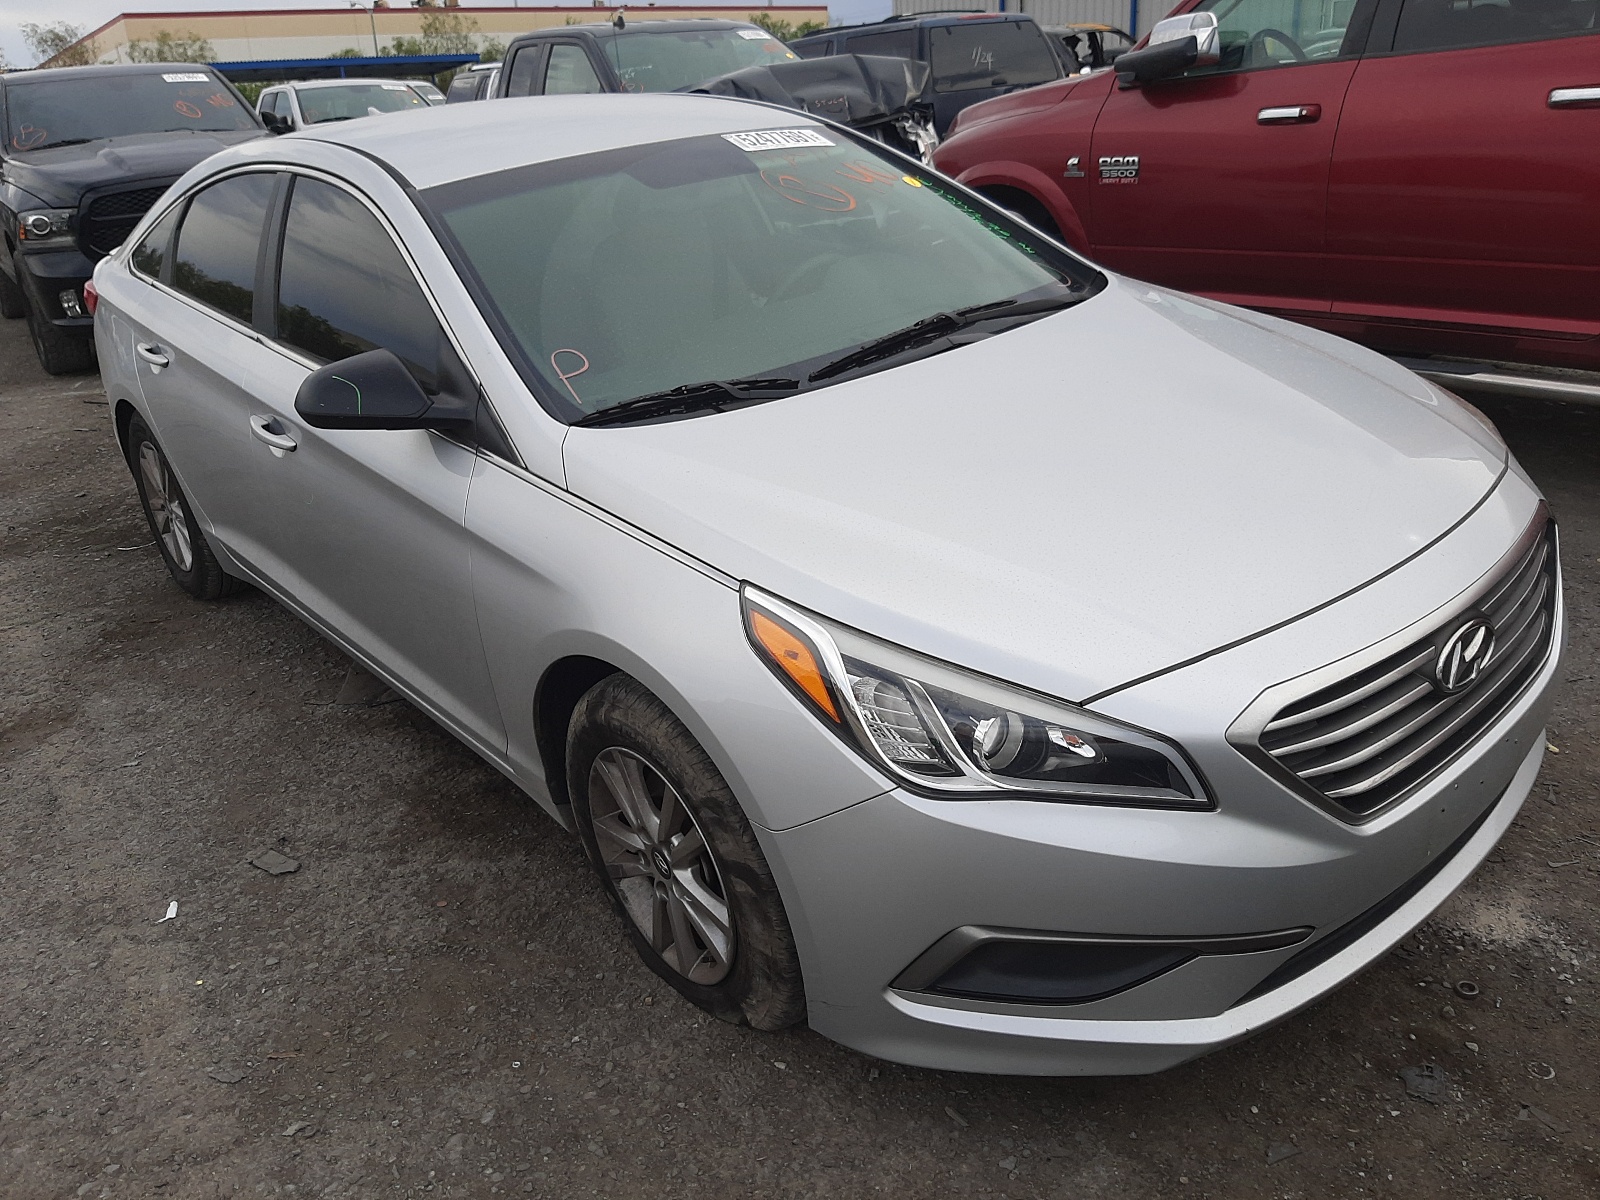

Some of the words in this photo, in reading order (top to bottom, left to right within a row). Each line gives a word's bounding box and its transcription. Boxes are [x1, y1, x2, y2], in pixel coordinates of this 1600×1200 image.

[735, 131, 817, 146] 52477691
[1098, 156, 1139, 167] RAM
[1101, 170, 1136, 178] 3500
[550, 348, 590, 405] P
